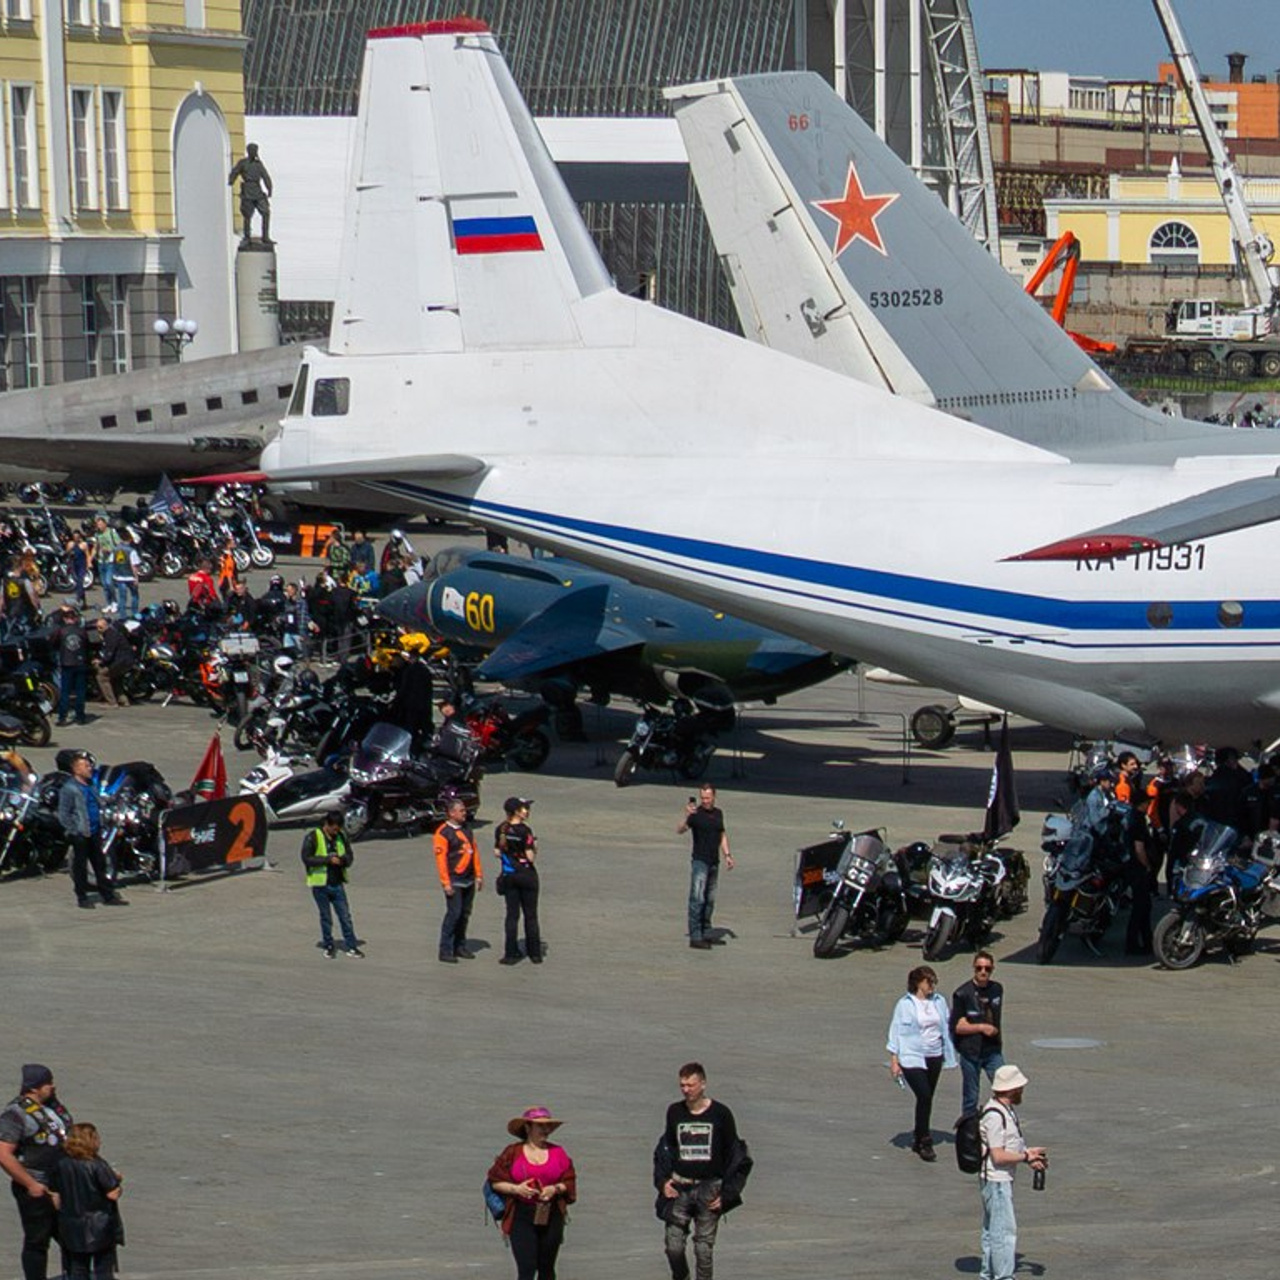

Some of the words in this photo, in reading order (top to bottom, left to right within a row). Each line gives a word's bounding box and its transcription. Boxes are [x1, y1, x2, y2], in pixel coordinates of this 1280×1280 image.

[788, 114, 809, 132] 66
[869, 288, 944, 308] 5302528
[465, 591, 495, 634] 60
[225, 801, 256, 864] 2
